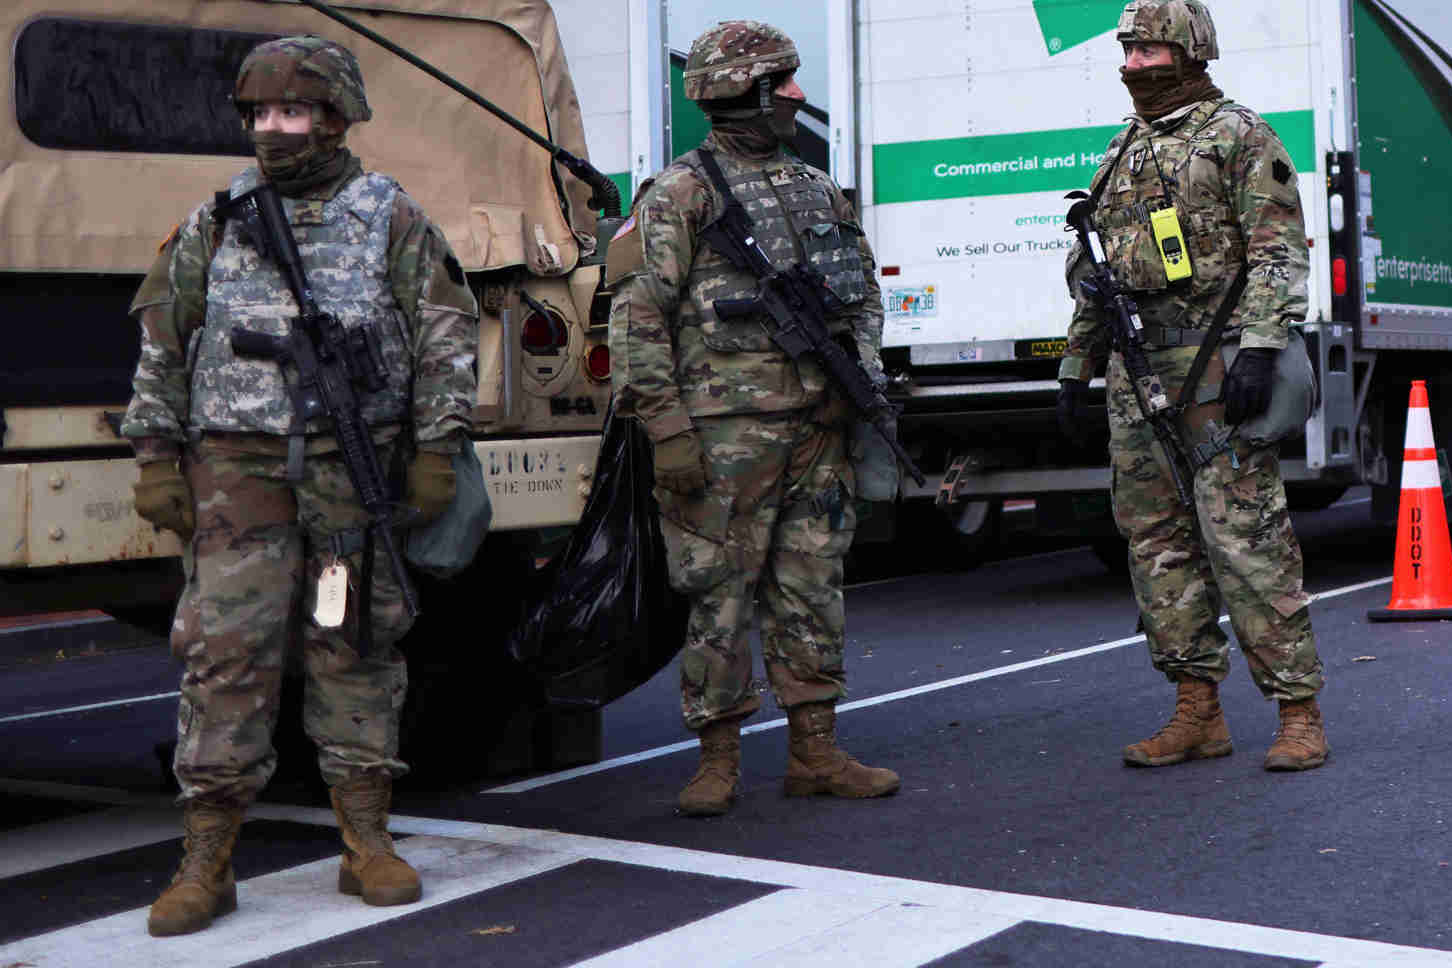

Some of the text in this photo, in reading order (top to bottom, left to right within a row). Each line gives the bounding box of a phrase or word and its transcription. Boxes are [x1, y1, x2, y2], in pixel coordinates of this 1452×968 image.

[933, 151, 1106, 178] Commercial and Ho
[1015, 214, 1067, 227] enterp
[936, 238, 1073, 258] We Sell Our Trucks
[1032, 342, 1069, 355] MAXO
[1410, 506, 1423, 580] DDOT
